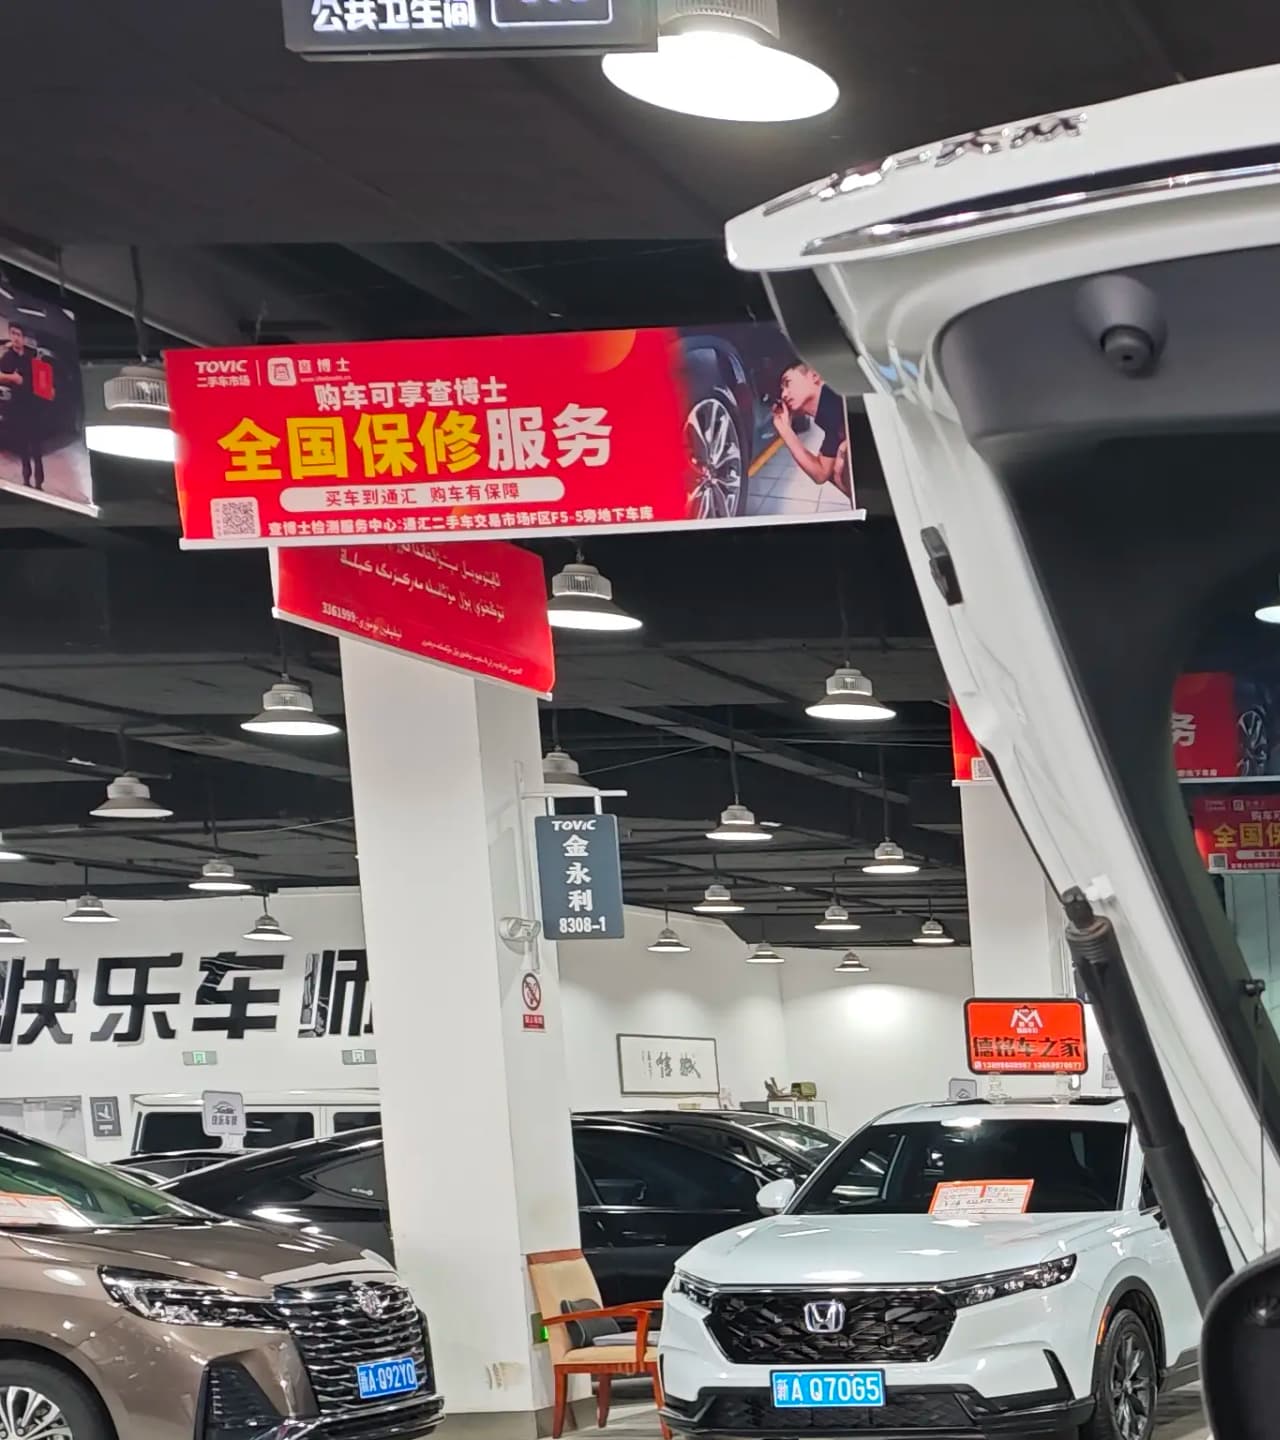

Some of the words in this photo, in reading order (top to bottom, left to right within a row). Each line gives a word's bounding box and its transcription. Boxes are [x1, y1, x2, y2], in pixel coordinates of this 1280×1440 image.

[311, 0, 476, 32] 公共卫生间
[195, 359, 248, 374] TOVIC
[196, 374, 250, 388] 二手车市场
[314, 376, 507, 412] 购车可享查博士
[217, 403, 613, 481] 全国保修服务
[326, 487, 417, 506] 买车到通汇
[430, 482, 520, 503] 购车有保障
[562, 833, 593, 912] 金永利
[559, 916, 607, 934] 8308-1
[0, 949, 374, 1046] 快乐车师
